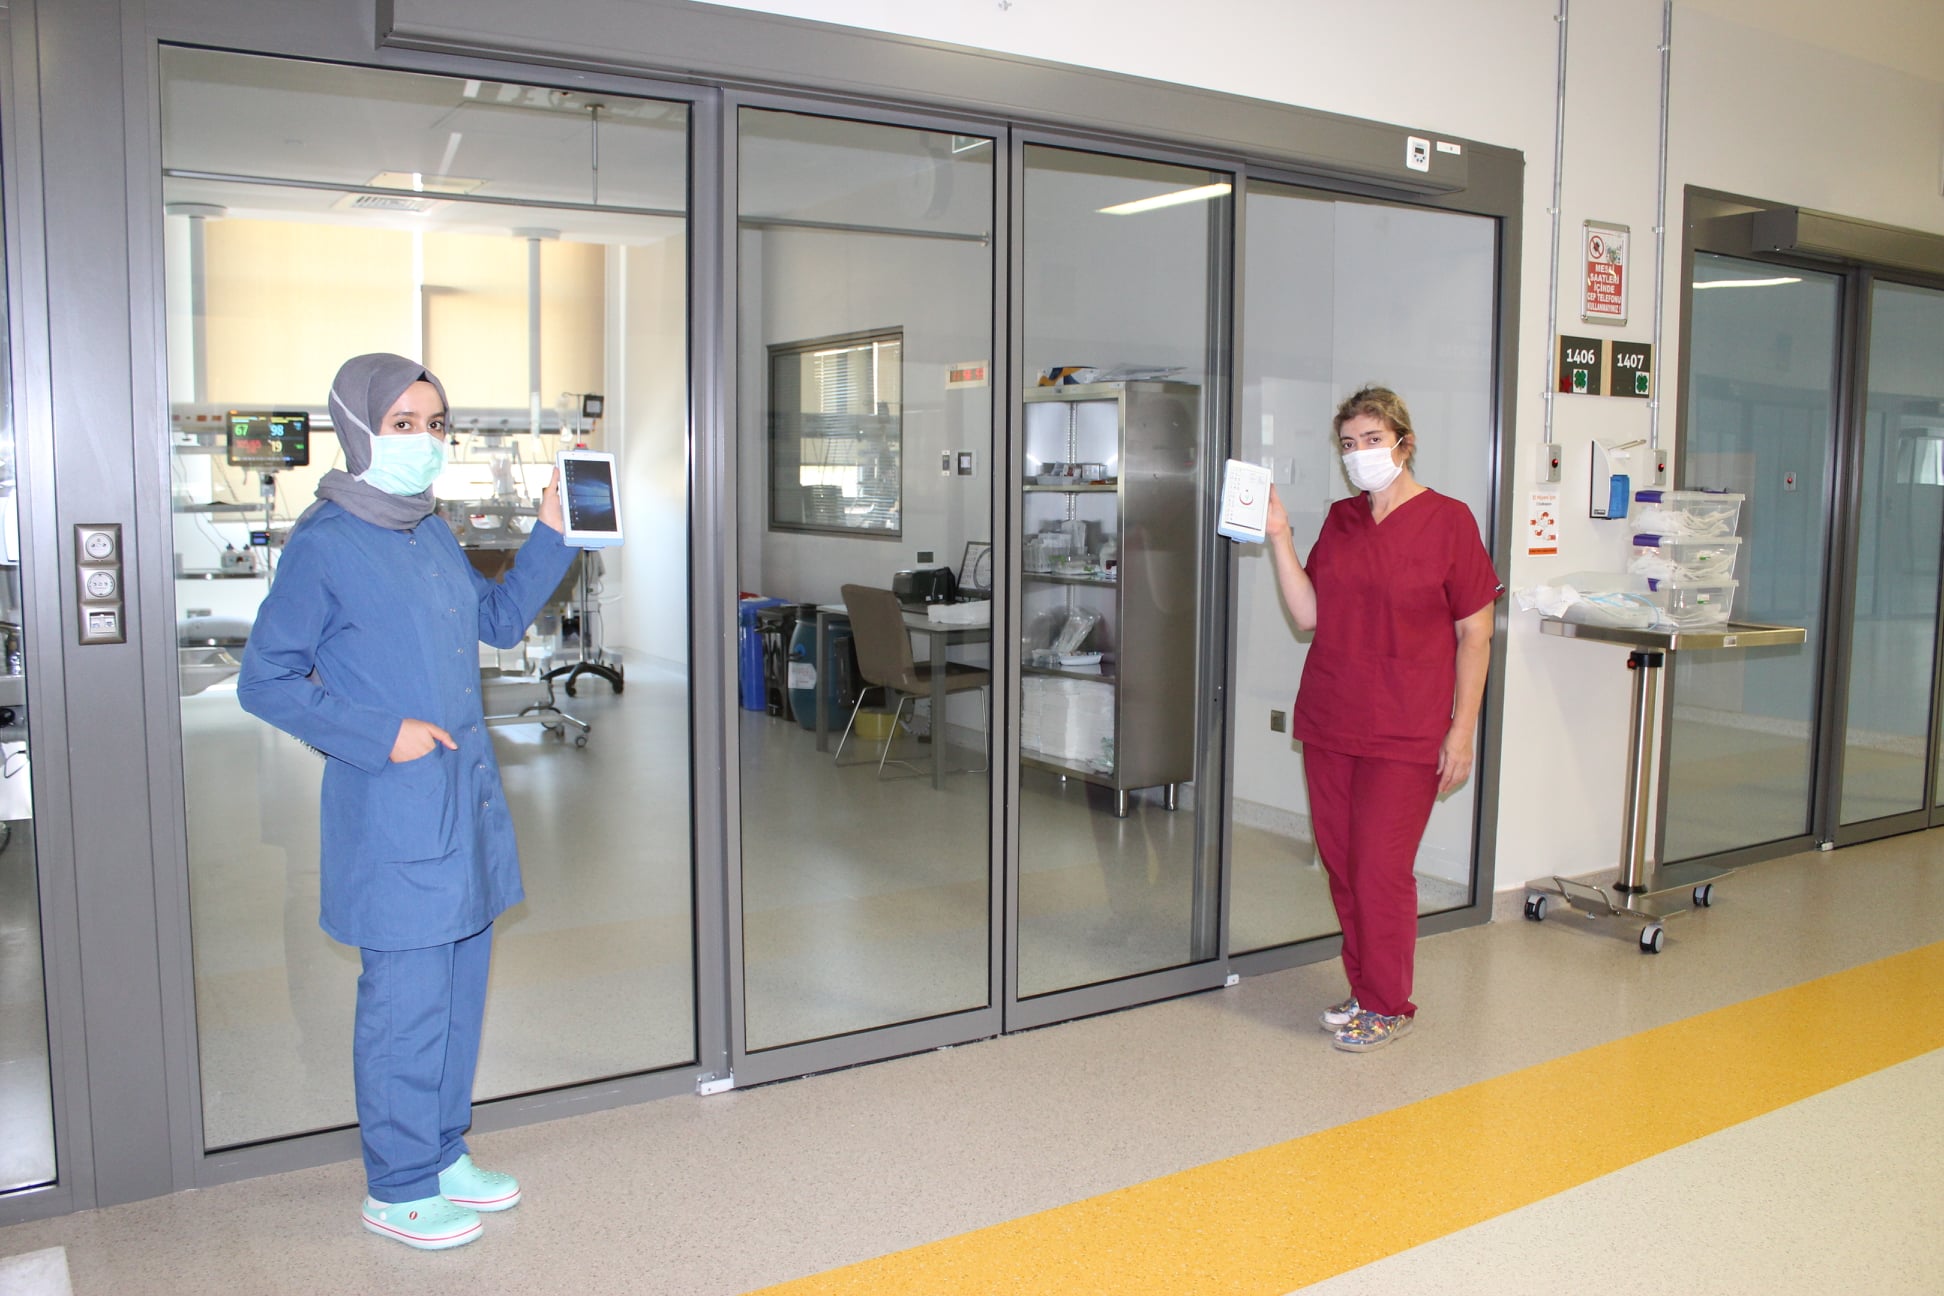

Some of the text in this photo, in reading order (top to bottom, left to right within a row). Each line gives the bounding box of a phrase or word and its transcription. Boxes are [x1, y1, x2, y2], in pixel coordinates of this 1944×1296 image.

[1590, 273, 1619, 284] SAATLERİ
[1594, 282, 1615, 293] İÇİNDE
[1566, 348, 1595, 364] 1406
[1617, 353, 1644, 369] 1407
[235, 424, 249, 436] 67
[270, 424, 284, 436] 98
[271, 440, 283, 452] 19
